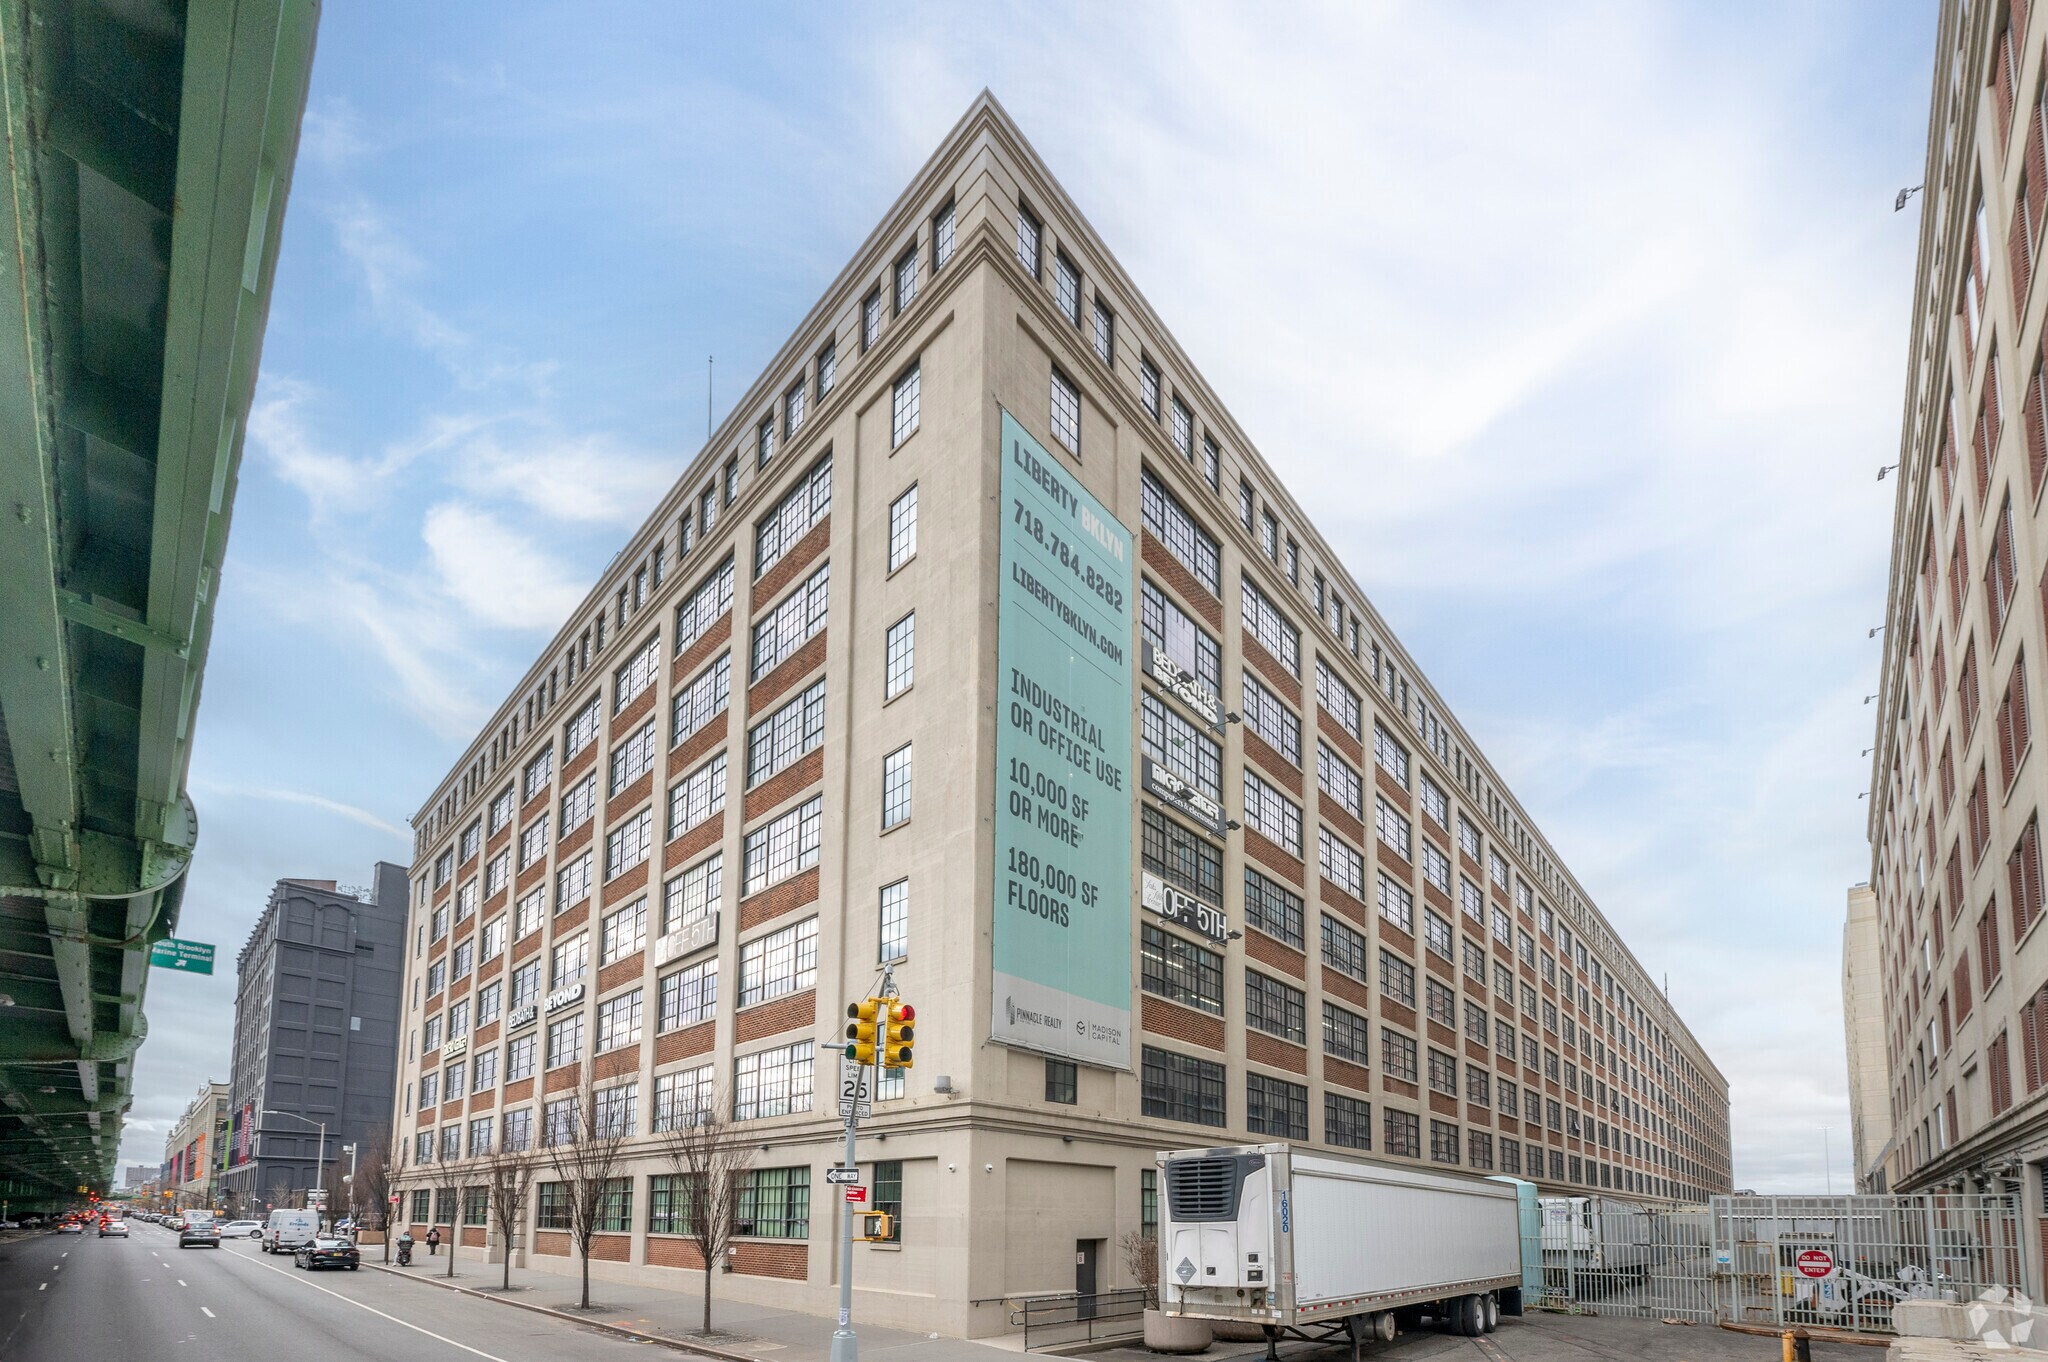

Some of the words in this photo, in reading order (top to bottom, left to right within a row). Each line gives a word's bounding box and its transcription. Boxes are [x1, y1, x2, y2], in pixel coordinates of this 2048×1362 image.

[1014, 439, 1078, 518] LIBERTY
[1081, 503, 1124, 562] BKLYN
[1013, 498, 1123, 613] 718.784.8282
[1012, 561, 1123, 666] LIBERTYBKLYN.COM
[1153, 646, 1177, 677] BED
[1011, 667, 1105, 753] INDUSTRIAL
[1153, 664, 1218, 724] BEYOND
[1010, 701, 1033, 736] OR
[1038, 719, 1091, 775] OFFICE
[1096, 757, 1122, 792] USE
[1009, 757, 1067, 811] 10,000
[1072, 793, 1090, 822] SF
[1009, 790, 1032, 823] OR
[1037, 804, 1078, 848] MORE
[1008, 846, 1077, 900] 180,000
[1081, 881, 1098, 908] SF
[1008, 879, 1069, 928] FLOORS
[1163, 887, 1195, 923] OFF
[1197, 902, 1227, 940] 5TH
[177, 943, 211, 954] Brooklyn
[691, 914, 716, 947] 5TH
[179, 951, 213, 962] Terminal
[544, 983, 582, 1013] BEYOND
[1016, 1007, 1042, 1025] PINNACLE
[1044, 1015, 1062, 1029] REALTY
[1092, 1024, 1121, 1037] MADISON
[1092, 1032, 1120, 1045] CAPITAL
[843, 1080, 867, 1099] 25
[841, 1109, 868, 1117] ENFRCED
[1281, 1190, 1289, 1233] 16020
